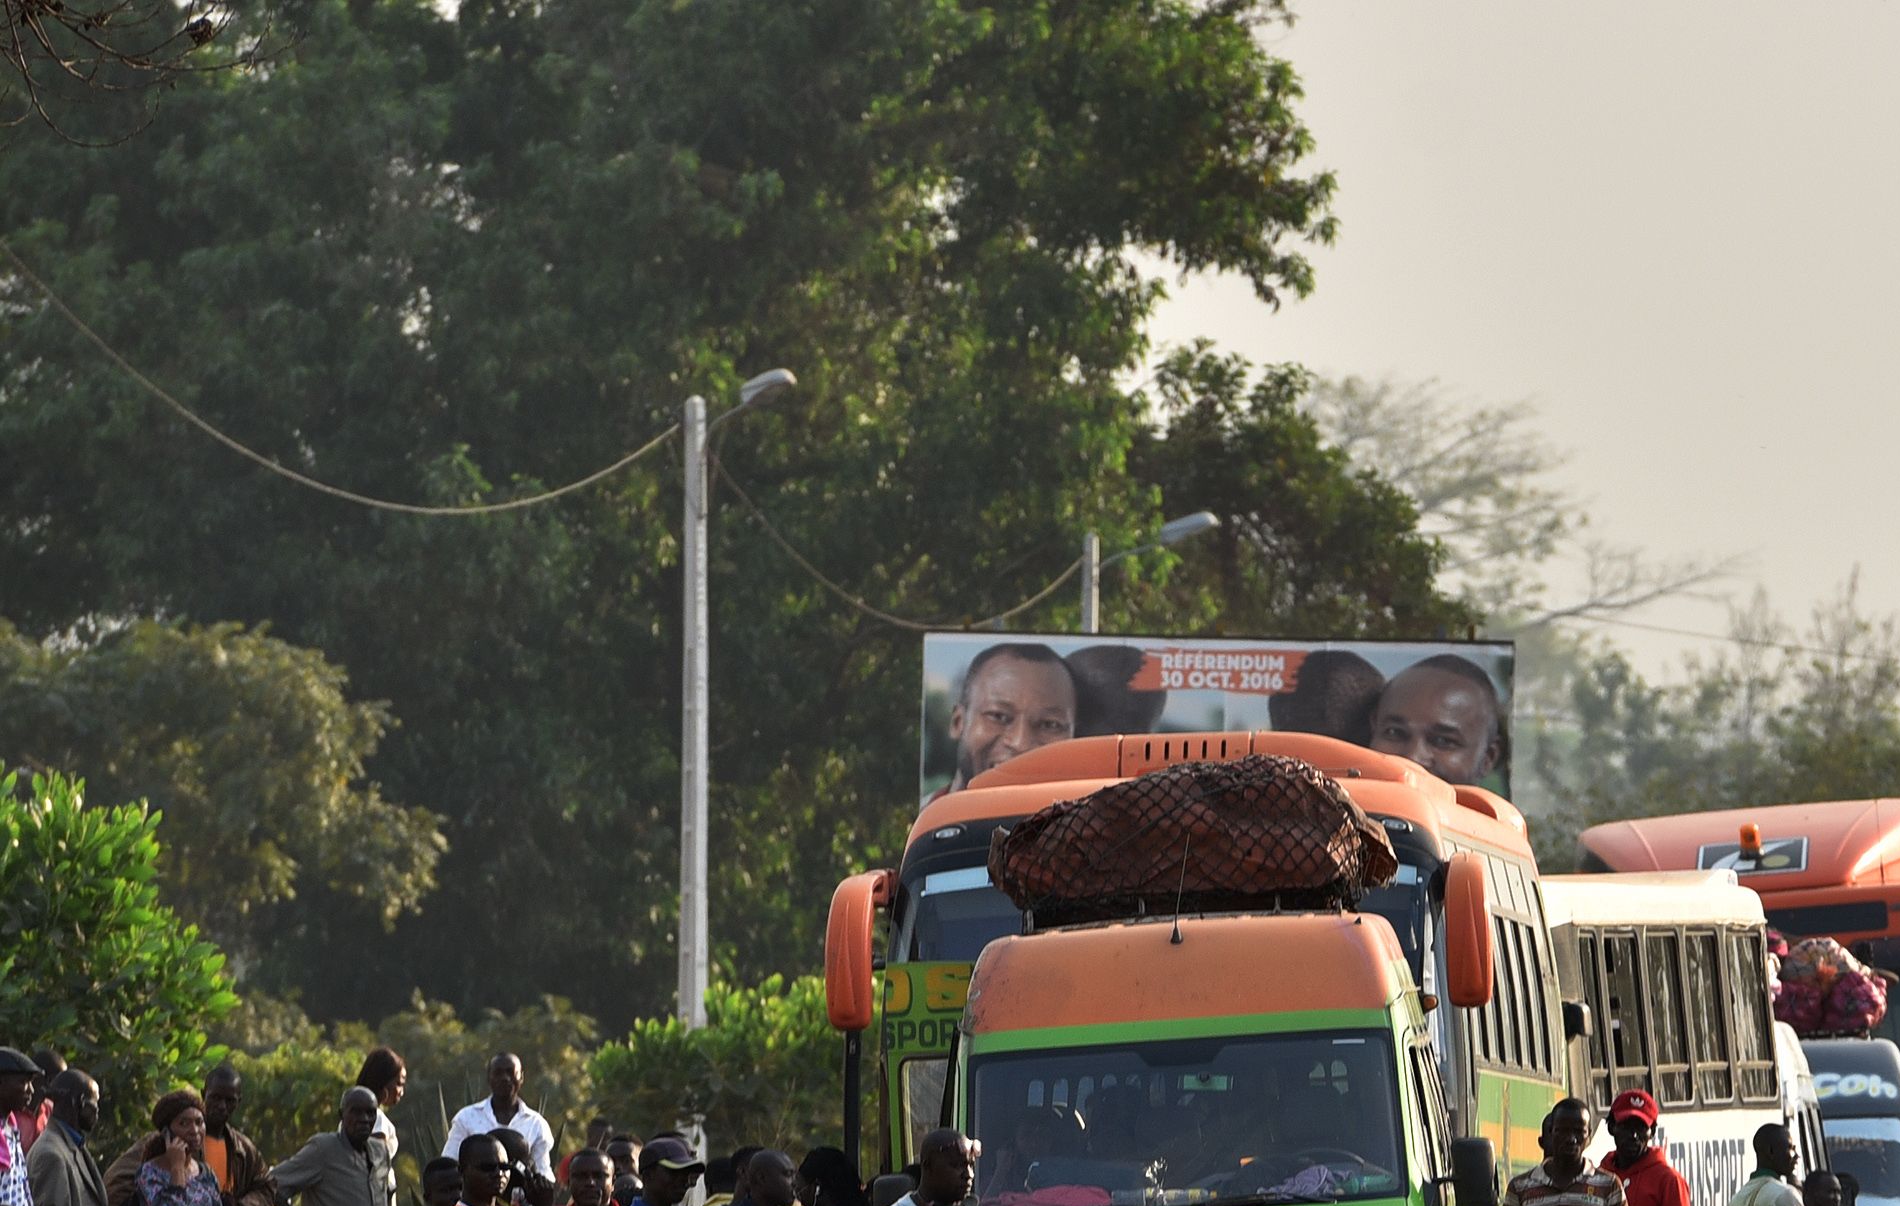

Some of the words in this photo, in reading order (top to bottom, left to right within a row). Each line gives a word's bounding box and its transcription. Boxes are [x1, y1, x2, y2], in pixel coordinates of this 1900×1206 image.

[1161, 651, 1286, 671] RÉFÉRENDUM
[1160, 671, 1184, 688] 30
[1187, 671, 1236, 689] OCT.
[1240, 672, 1285, 690] 2016
